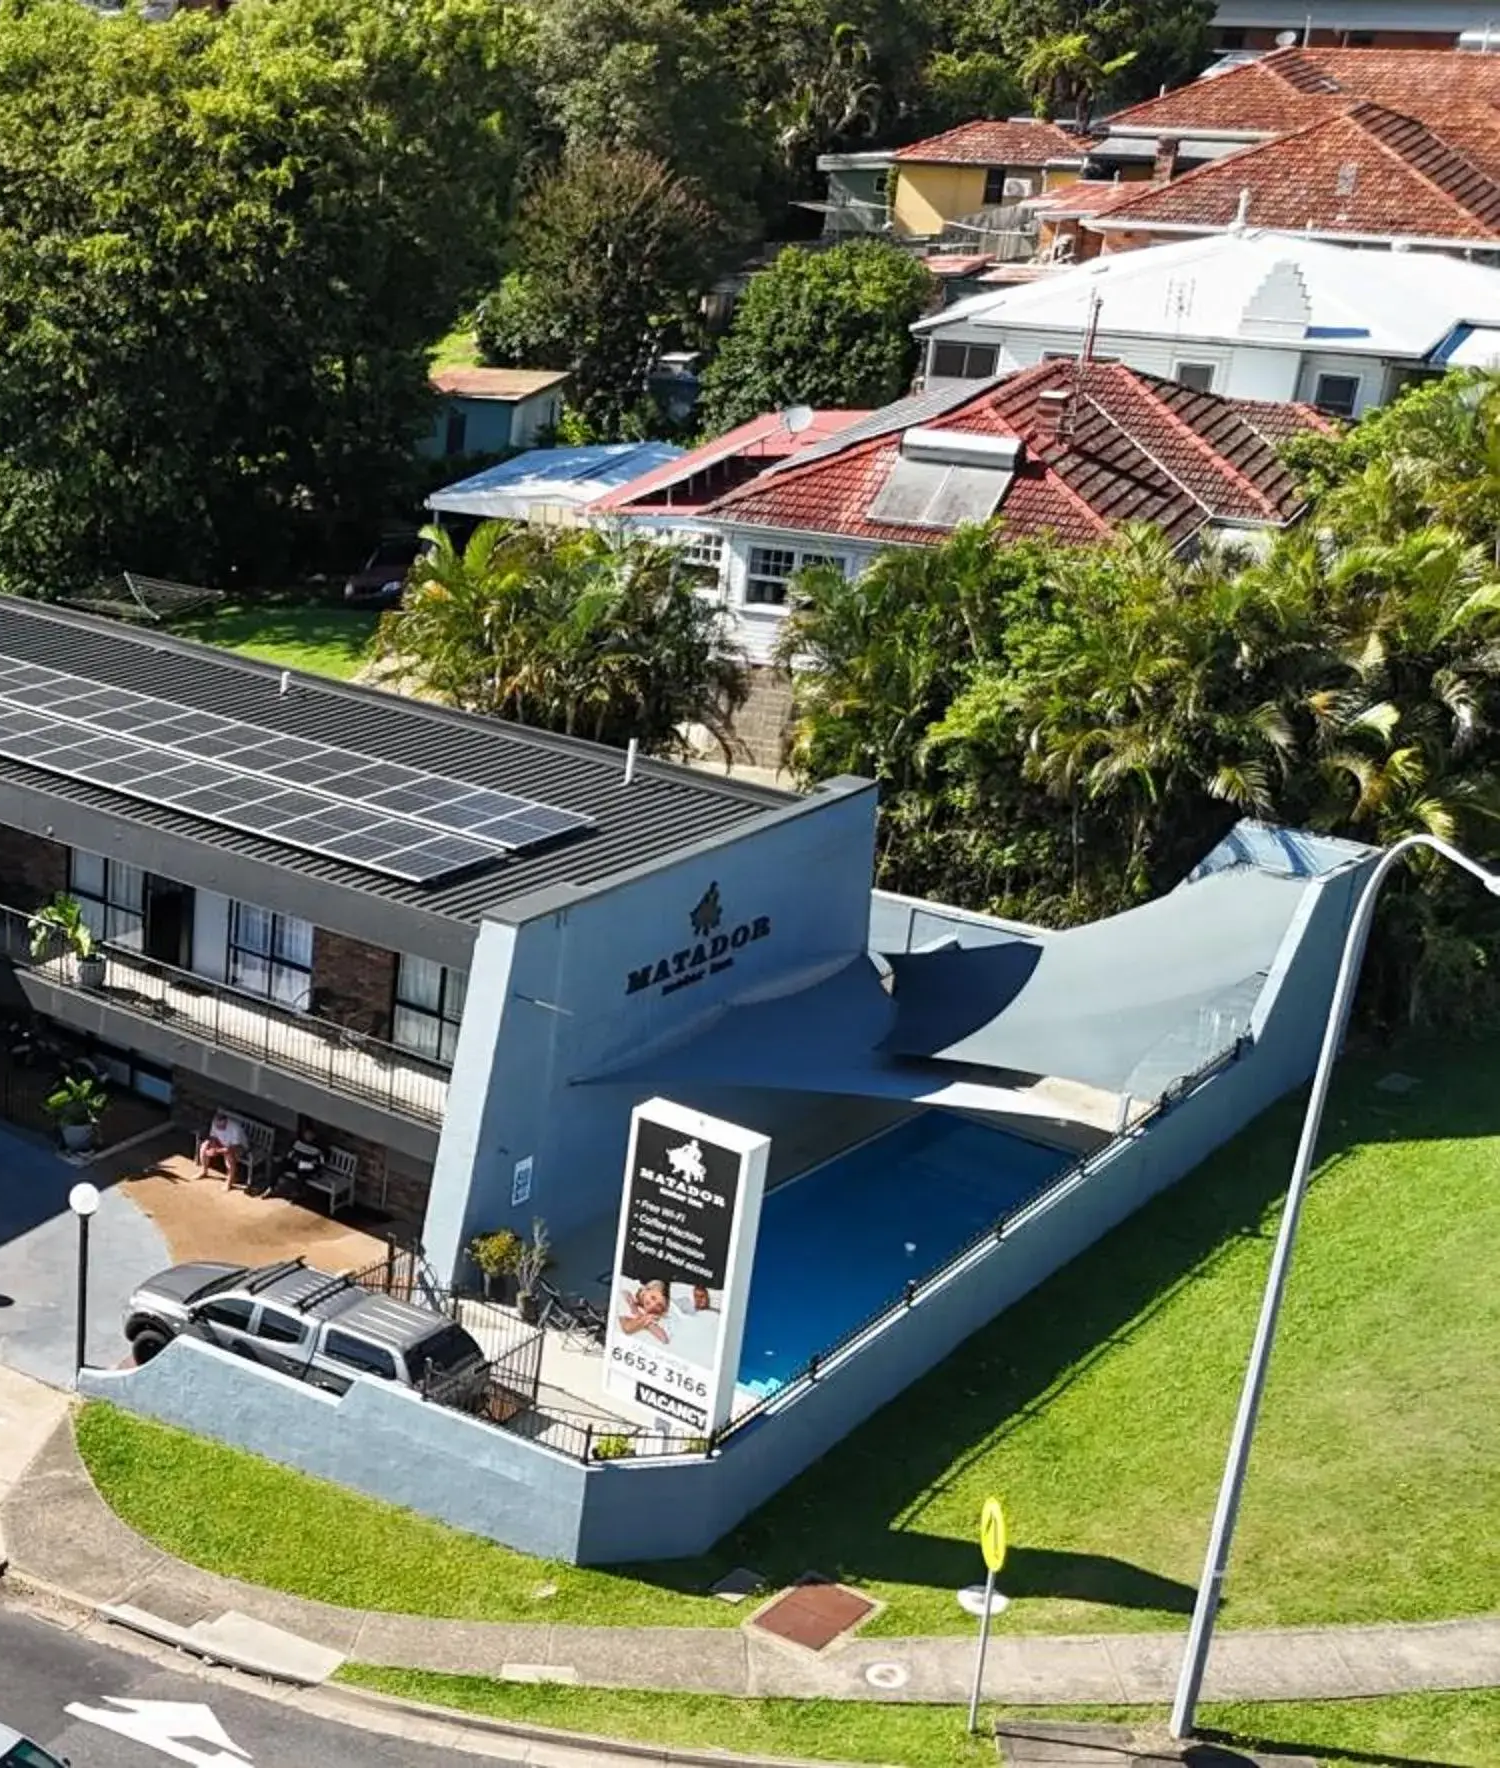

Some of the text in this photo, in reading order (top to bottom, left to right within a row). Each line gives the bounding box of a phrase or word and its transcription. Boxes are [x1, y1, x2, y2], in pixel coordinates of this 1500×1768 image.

[625, 915, 771, 995] MATADOR
[639, 1167, 726, 1208] MATADOR
[641, 1199, 661, 1214] Free
[637, 1227, 665, 1245] Smart
[639, 1213, 704, 1245] Coffee Machine
[635, 1241, 657, 1256] Gym
[656, 1249, 665, 1259] &
[664, 1253, 686, 1266] Pool
[611, 1346, 659, 1376] 6652
[664, 1367, 707, 1397] 3166
[639, 1385, 707, 1427] VACANCY
